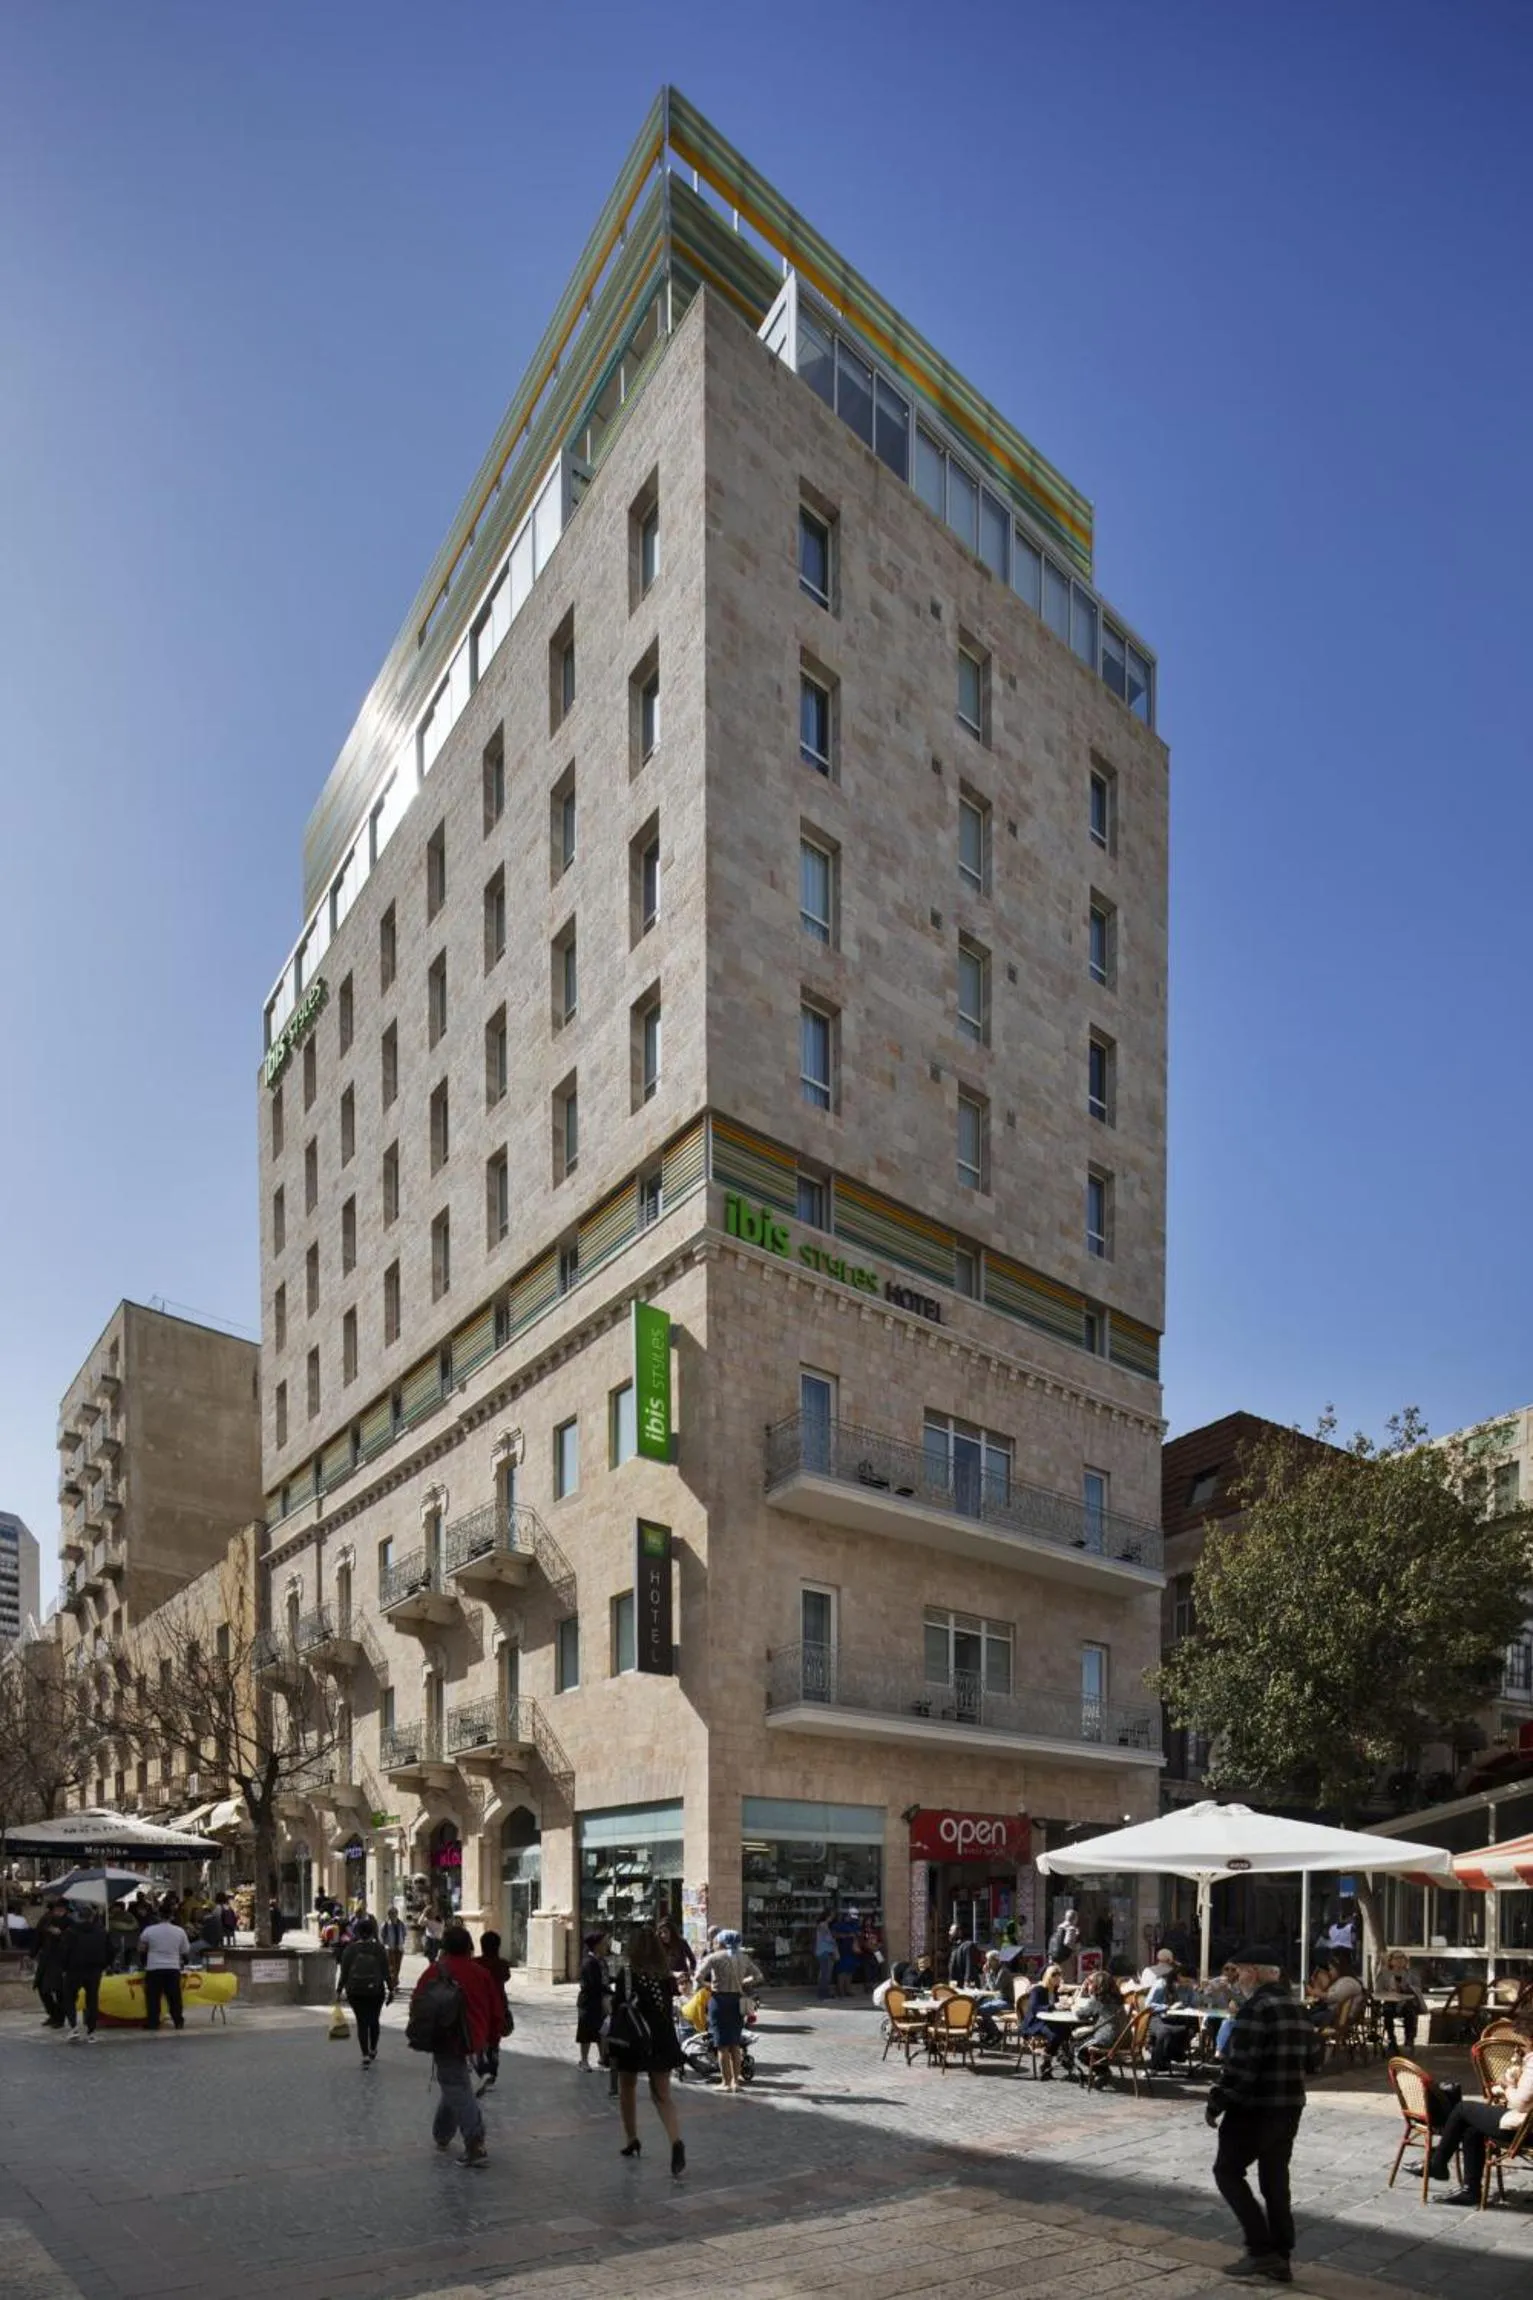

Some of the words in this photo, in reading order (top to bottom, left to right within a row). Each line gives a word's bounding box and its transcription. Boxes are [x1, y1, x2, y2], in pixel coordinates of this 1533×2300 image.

[724, 1190, 791, 1259] ibis
[885, 1282, 943, 1325] HOTEL
[644, 1396, 666, 1443] ibis
[649, 1569, 661, 1664] HOTEL
[939, 1817, 1006, 1855] open
